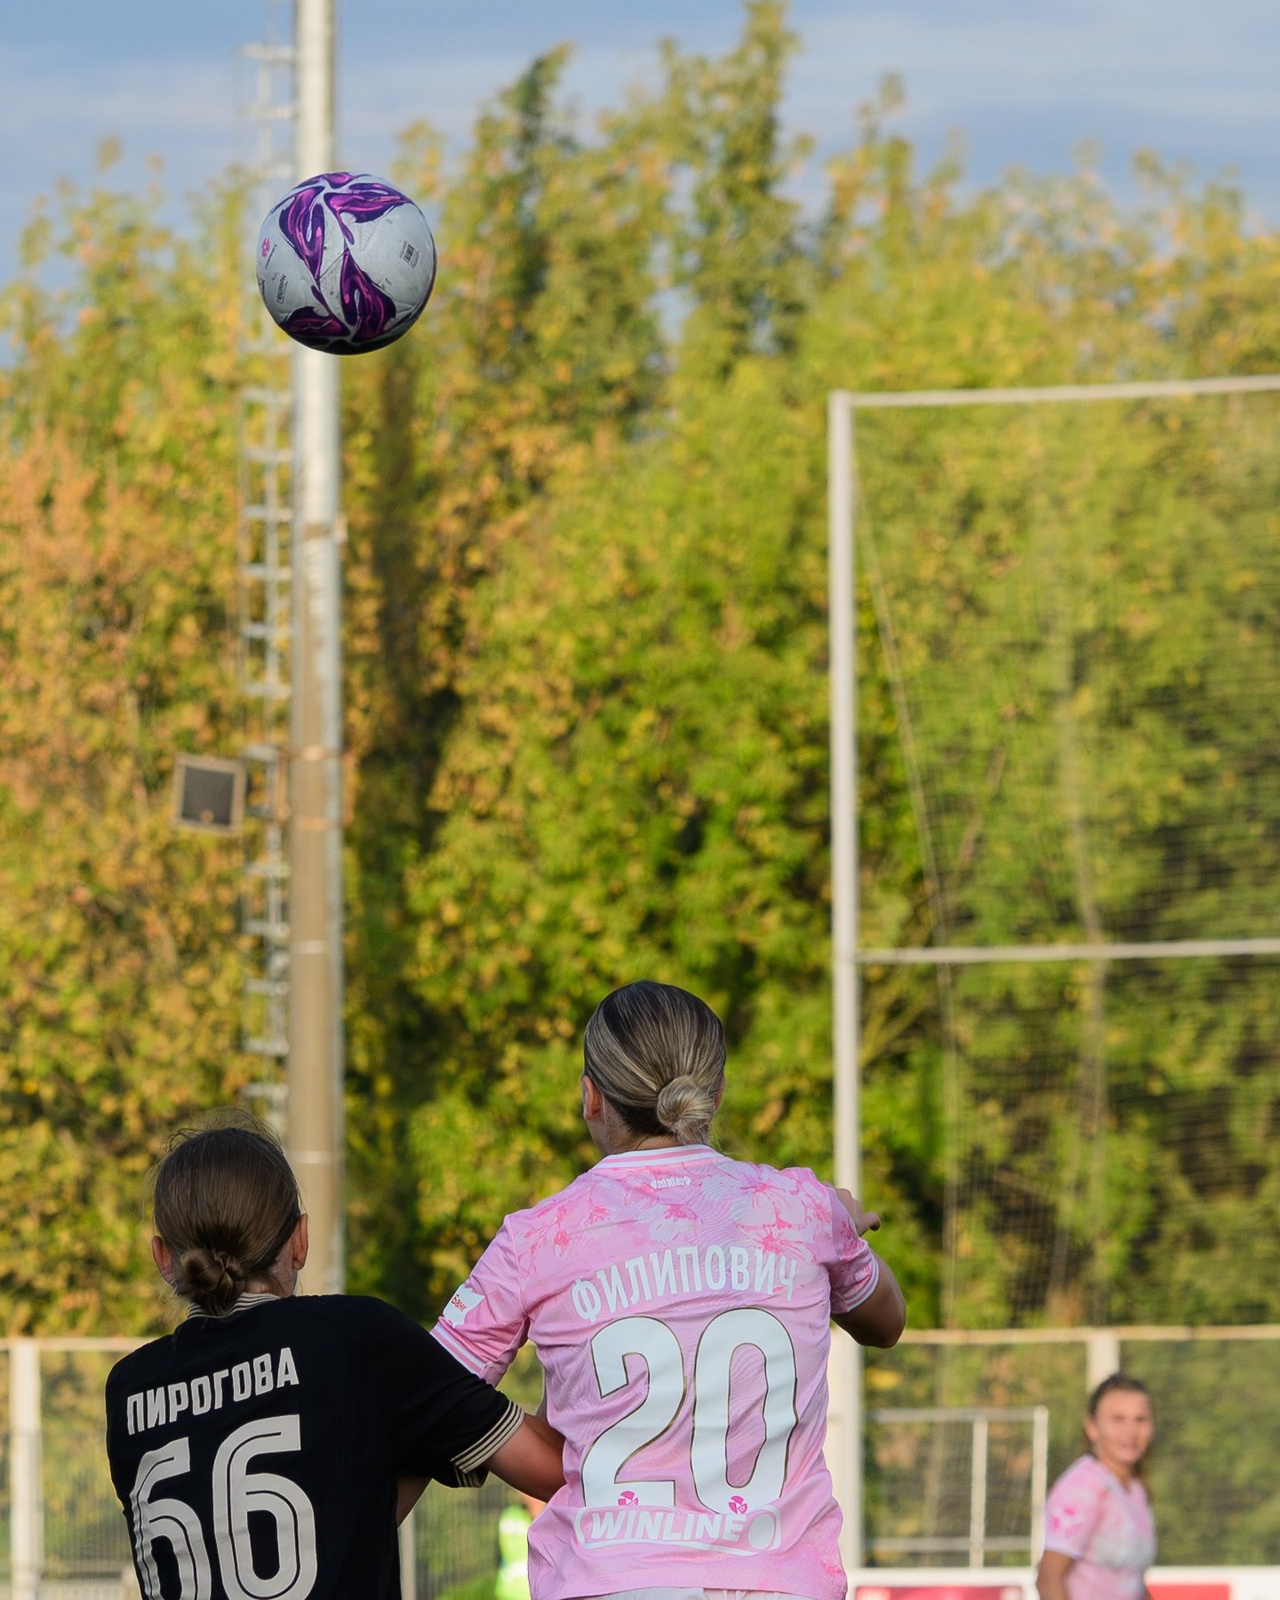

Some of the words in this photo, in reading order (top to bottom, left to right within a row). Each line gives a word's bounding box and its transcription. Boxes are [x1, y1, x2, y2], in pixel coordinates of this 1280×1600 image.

[571, 1245, 798, 1322] ФИЛИПОВИЧ
[127, 1347, 299, 1435] ПИРОГОВА
[581, 1307, 799, 1515] 20
[591, 1510, 747, 1542] WINLINE
